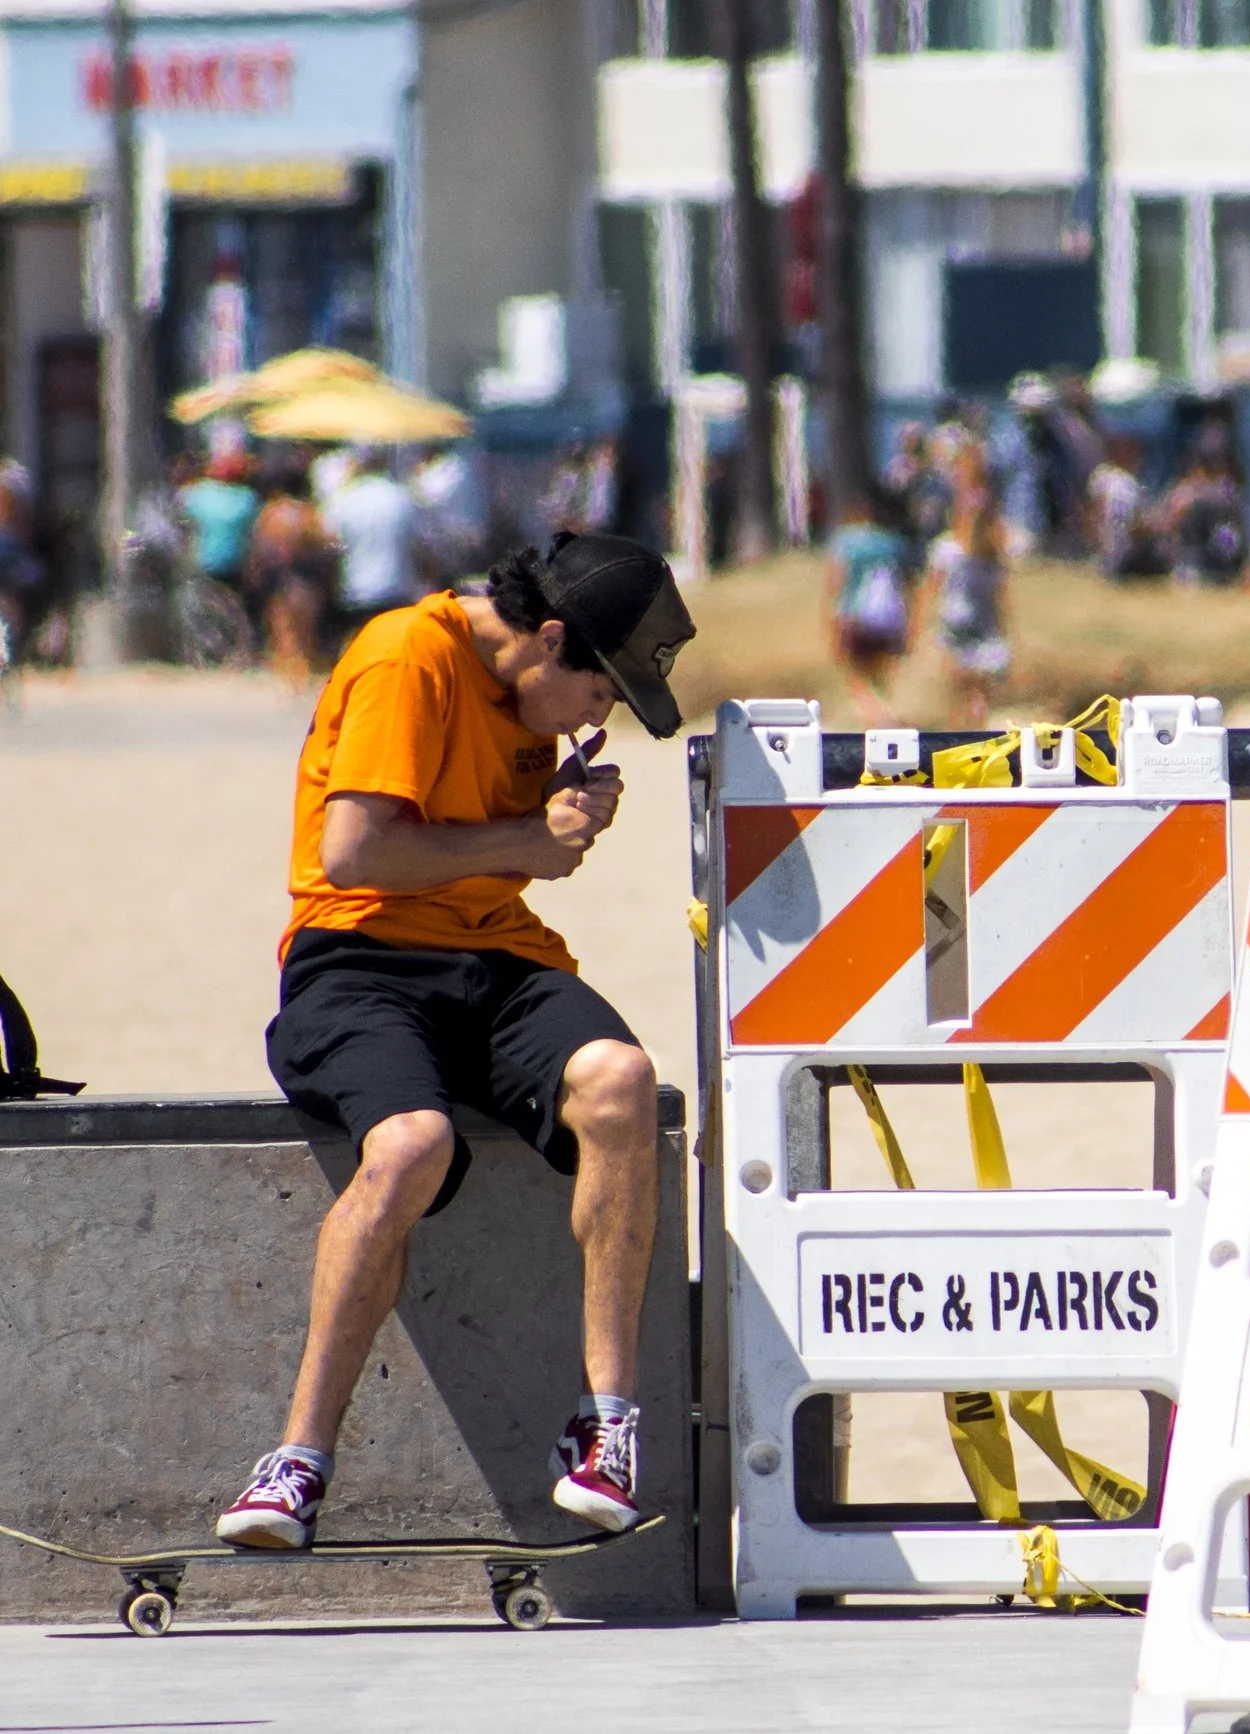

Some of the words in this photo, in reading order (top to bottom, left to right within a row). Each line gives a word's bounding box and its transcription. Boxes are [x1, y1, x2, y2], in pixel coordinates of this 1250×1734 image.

[84, 50, 294, 112] MARKET
[822, 1272, 925, 1334] REC
[942, 1274, 974, 1333] &
[990, 1269, 1159, 1332] PARKS
